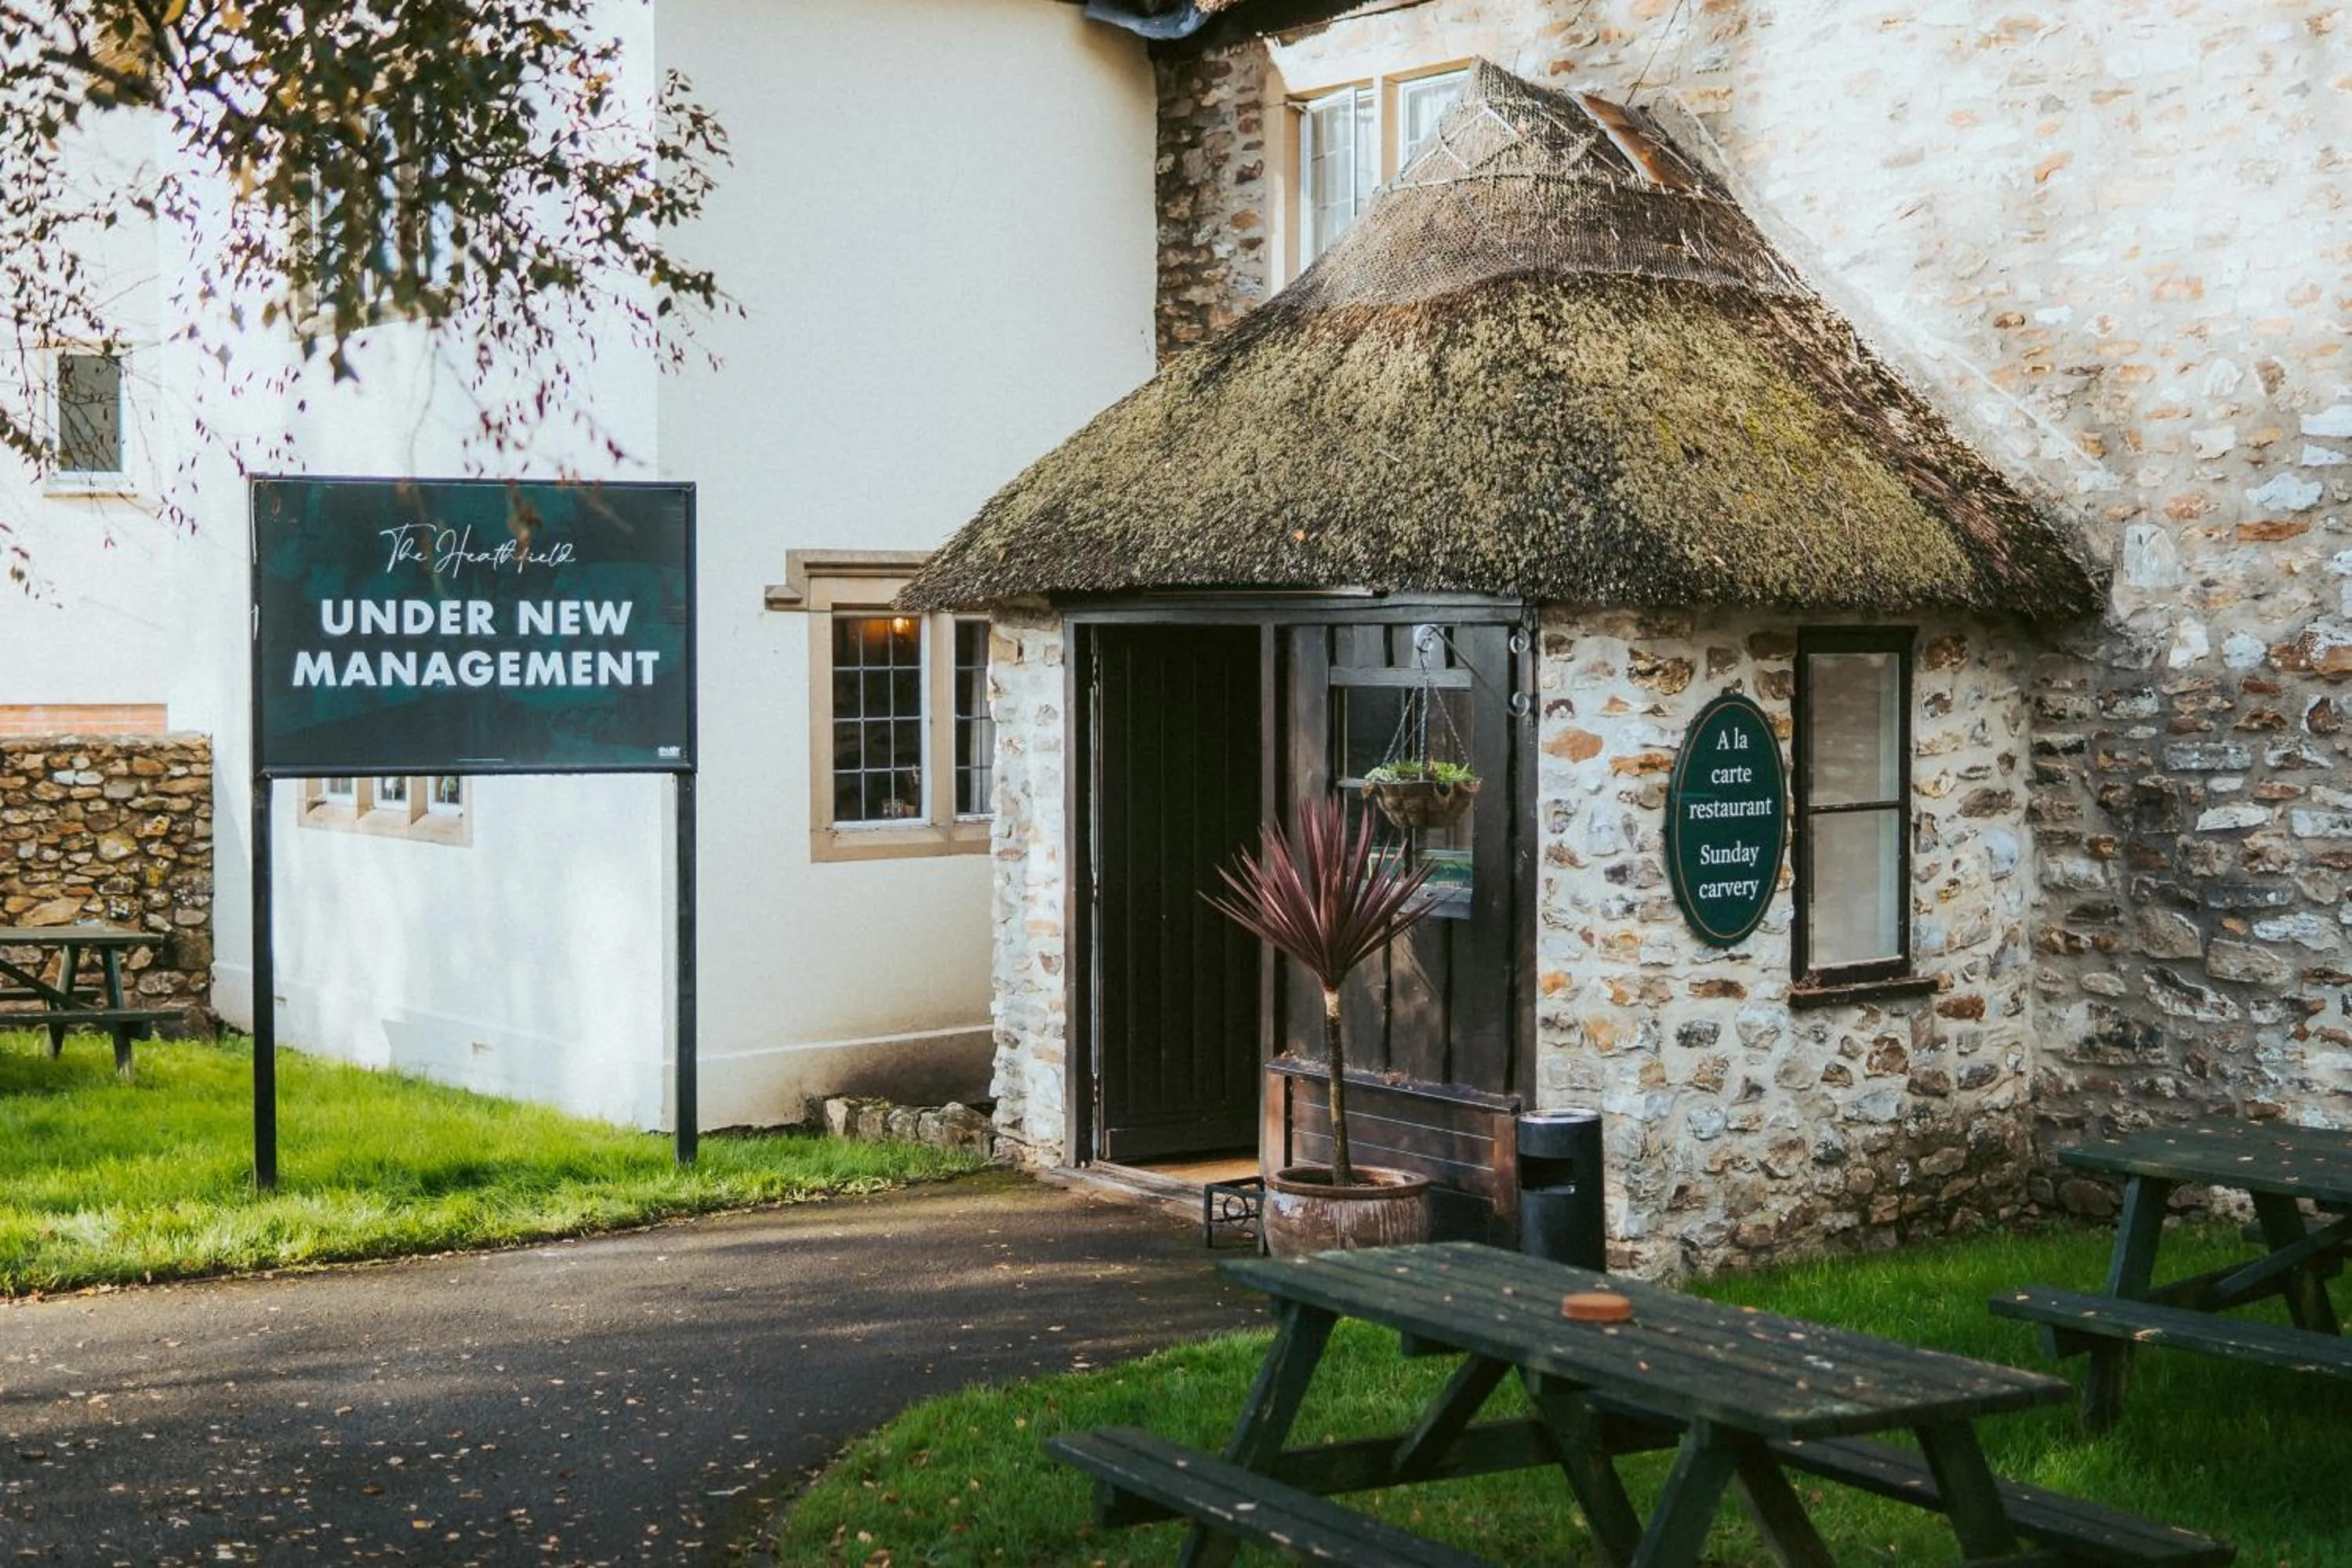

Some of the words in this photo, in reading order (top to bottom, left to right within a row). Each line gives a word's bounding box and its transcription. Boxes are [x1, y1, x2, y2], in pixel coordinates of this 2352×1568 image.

[379, 523, 436, 573] The
[434, 524, 576, 578] Heathfield
[321, 599, 497, 636] UNDER
[518, 601, 633, 635] NEW
[293, 651, 660, 687] MANAGEMENT
[1715, 729, 1730, 750] A
[1733, 727, 1748, 750] la
[1711, 765, 1752, 784] carte
[1689, 797, 1773, 819] restaurant
[1700, 840, 1759, 866] Sunday
[1699, 879, 1759, 900] carvery
